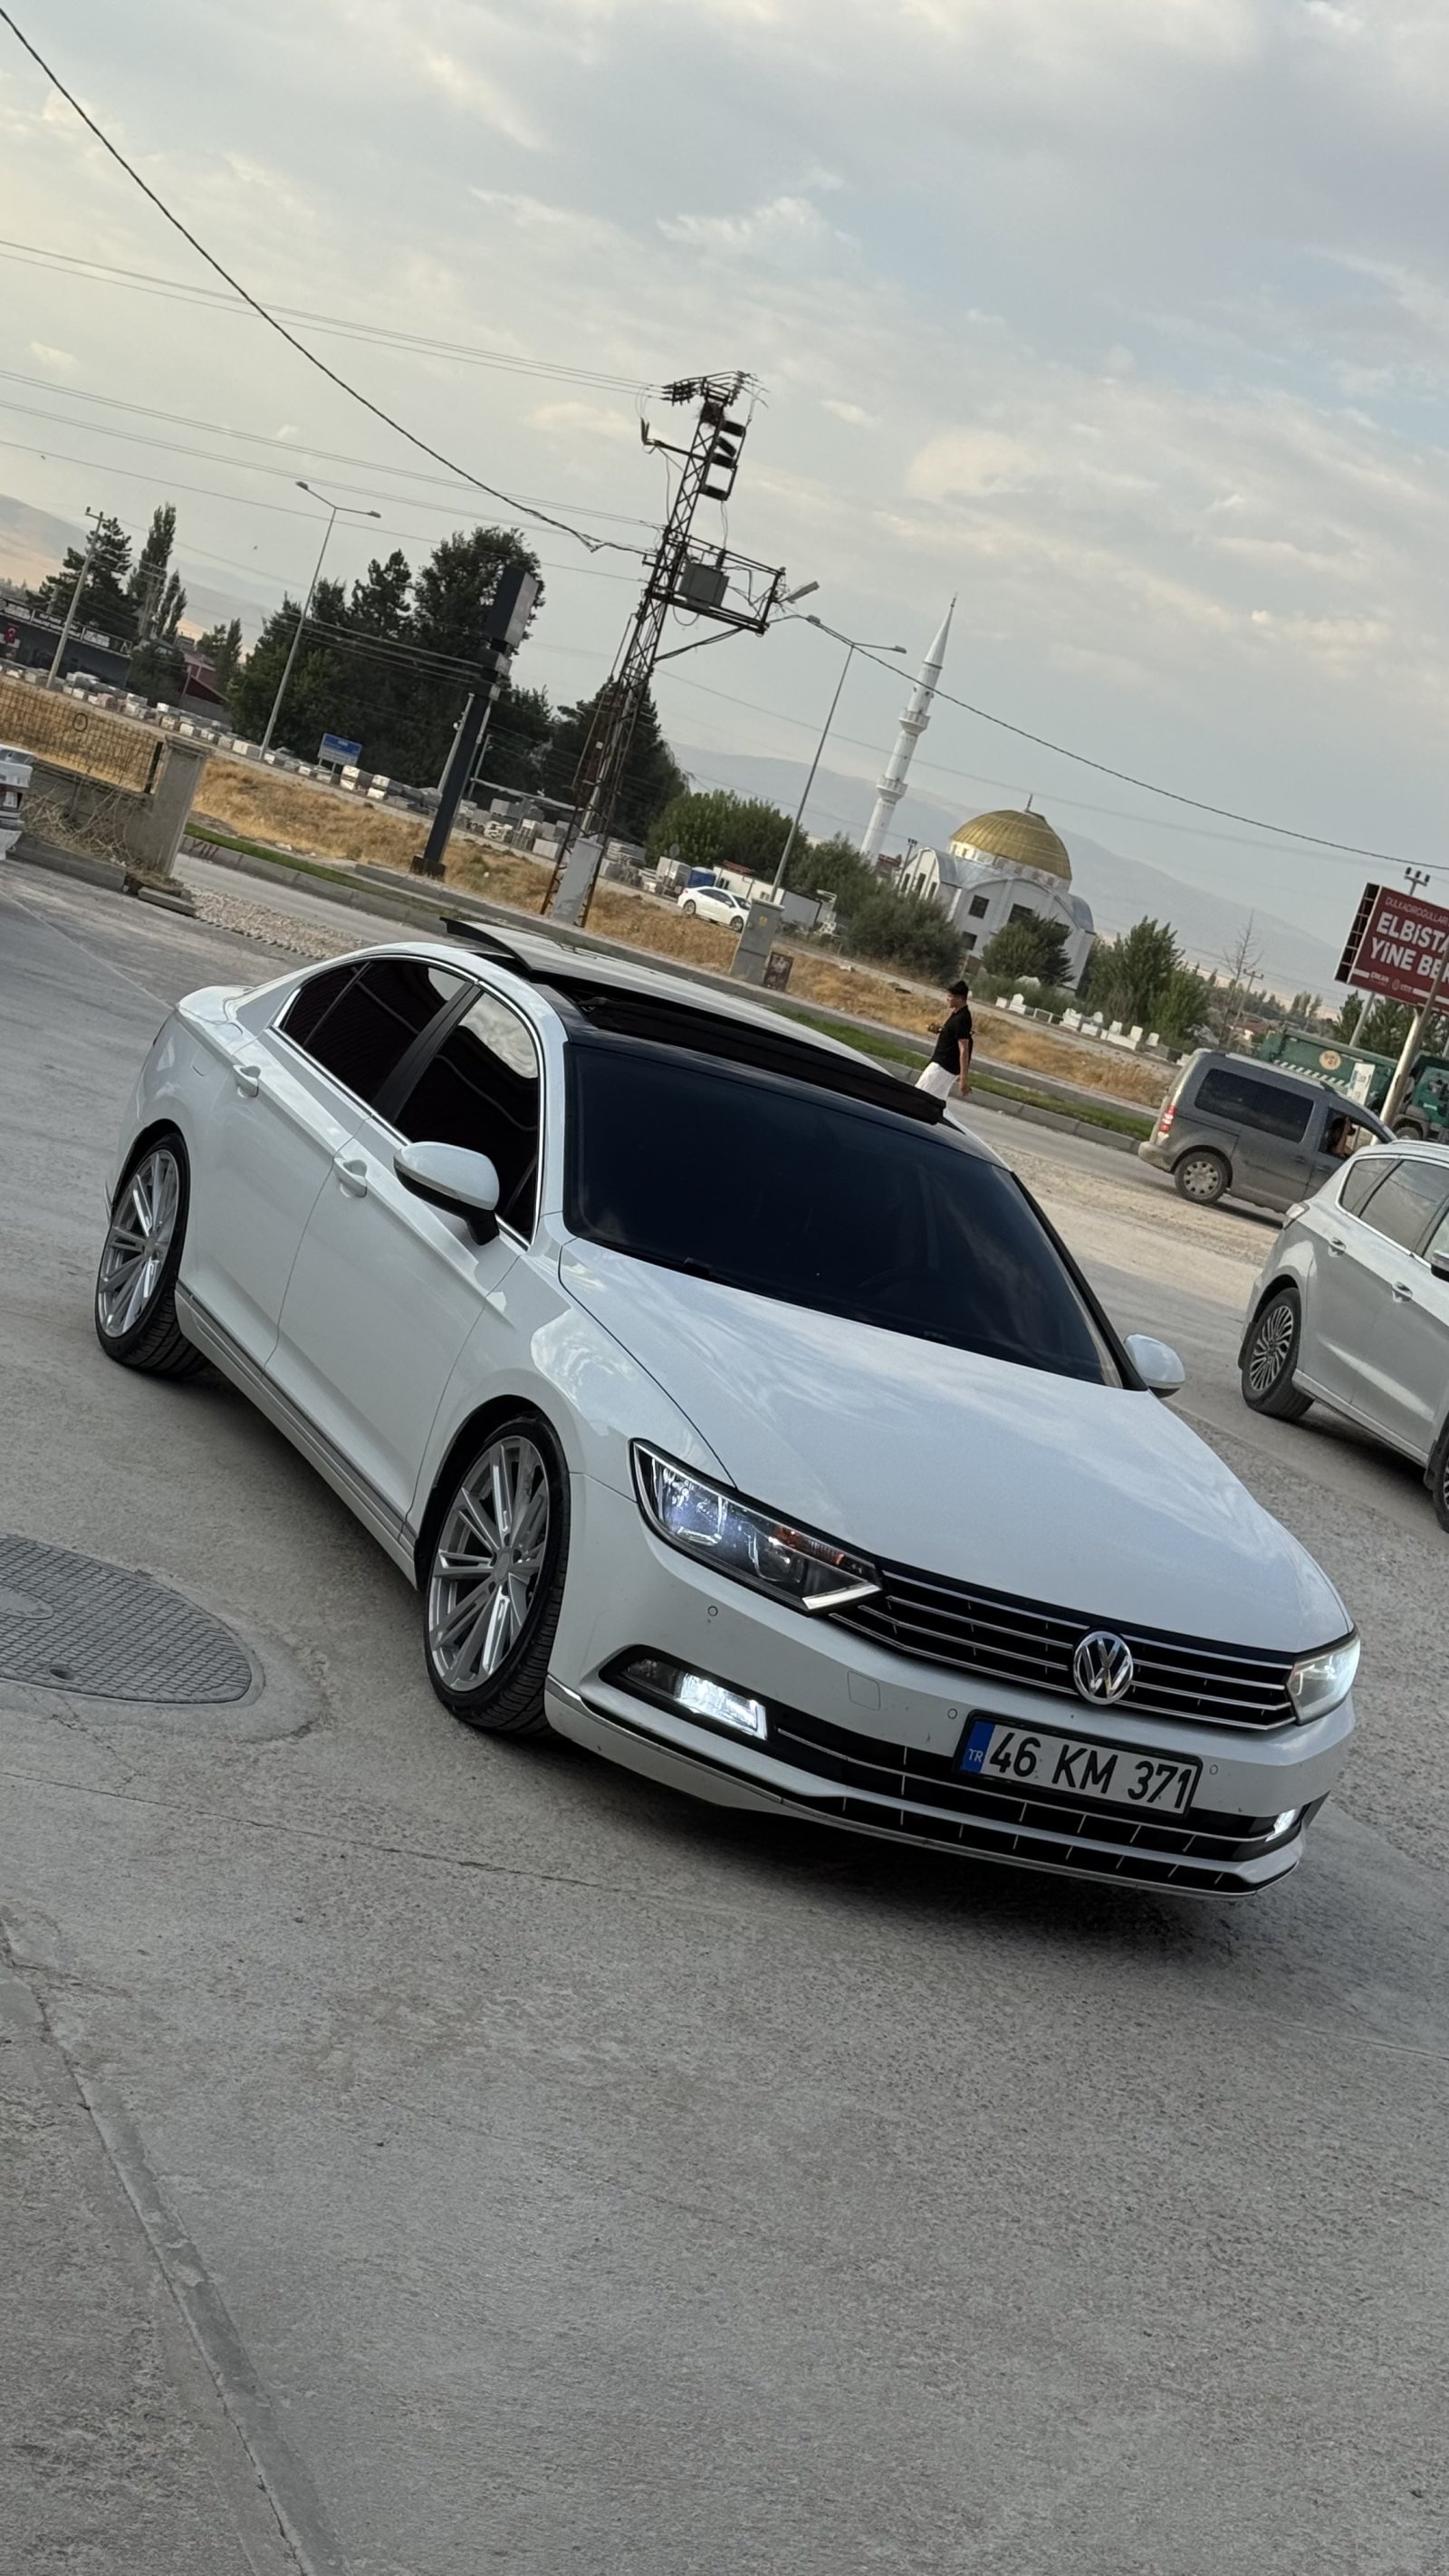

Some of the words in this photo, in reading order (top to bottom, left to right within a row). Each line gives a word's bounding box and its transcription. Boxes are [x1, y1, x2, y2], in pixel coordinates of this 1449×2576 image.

[968, 1748, 984, 1764] TR
[989, 1732, 1041, 1777] 46
[1051, 1744, 1118, 1794] KM
[1128, 1760, 1192, 1809] 371
